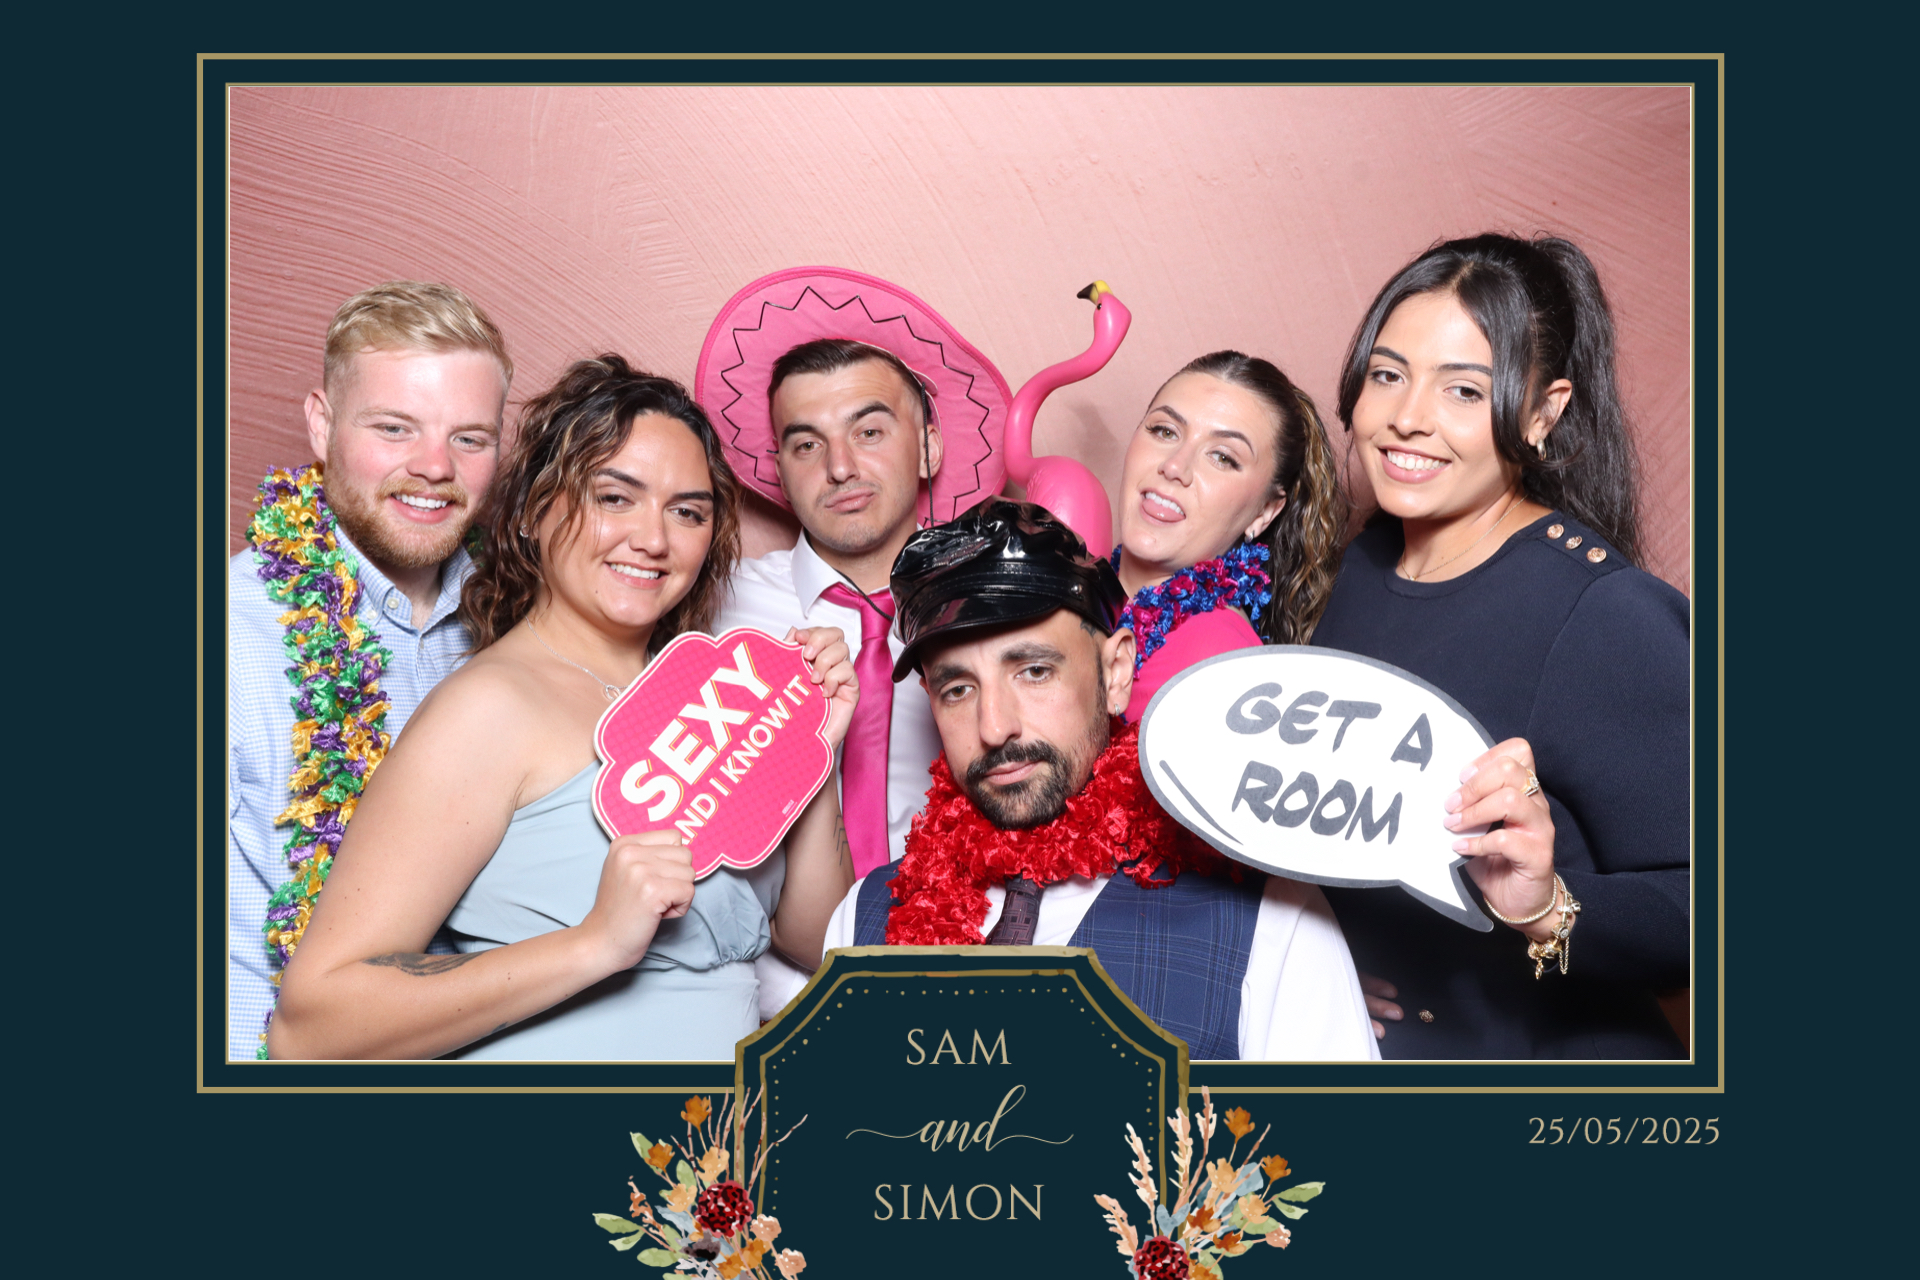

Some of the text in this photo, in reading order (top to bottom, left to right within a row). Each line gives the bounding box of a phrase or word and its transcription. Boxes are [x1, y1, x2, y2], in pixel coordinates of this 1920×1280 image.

[620, 641, 773, 822] SEXY
[783, 674, 812, 706] IT
[1225, 682, 1433, 772] GET A
[719, 697, 792, 784] KNOW
[674, 793, 719, 846] ND
[709, 777, 732, 797] I
[1231, 760, 1403, 845] ROOM
